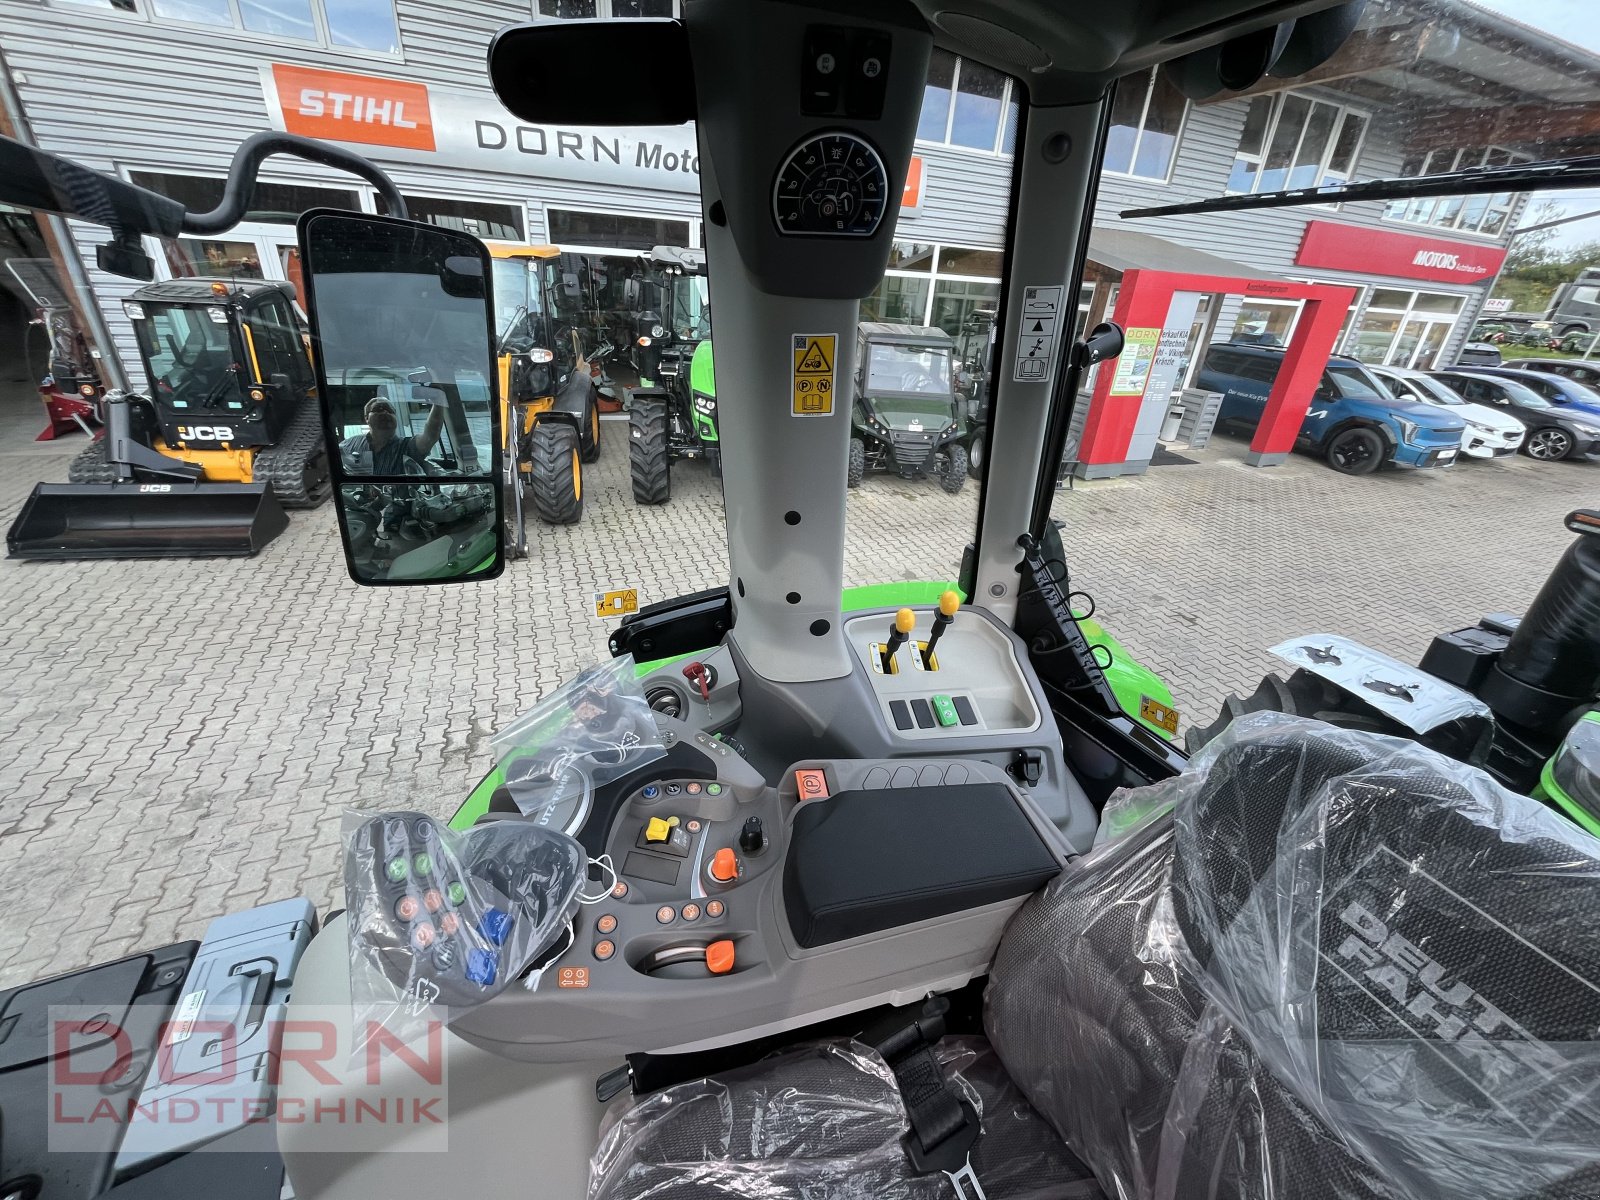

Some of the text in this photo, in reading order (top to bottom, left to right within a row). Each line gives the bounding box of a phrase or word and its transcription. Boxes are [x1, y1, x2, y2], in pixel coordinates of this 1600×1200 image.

[299, 89, 417, 129] STIHL
[475, 120, 621, 165] DORN
[1412, 250, 1459, 270] MOTORS
[1127, 329, 1157, 339] DORN
[1161, 330, 1189, 339] erkauf KIA
[178, 426, 235, 441] JCB
[140, 484, 172, 493] JCB
[540, 774, 571, 826] UTZ-FAHR
